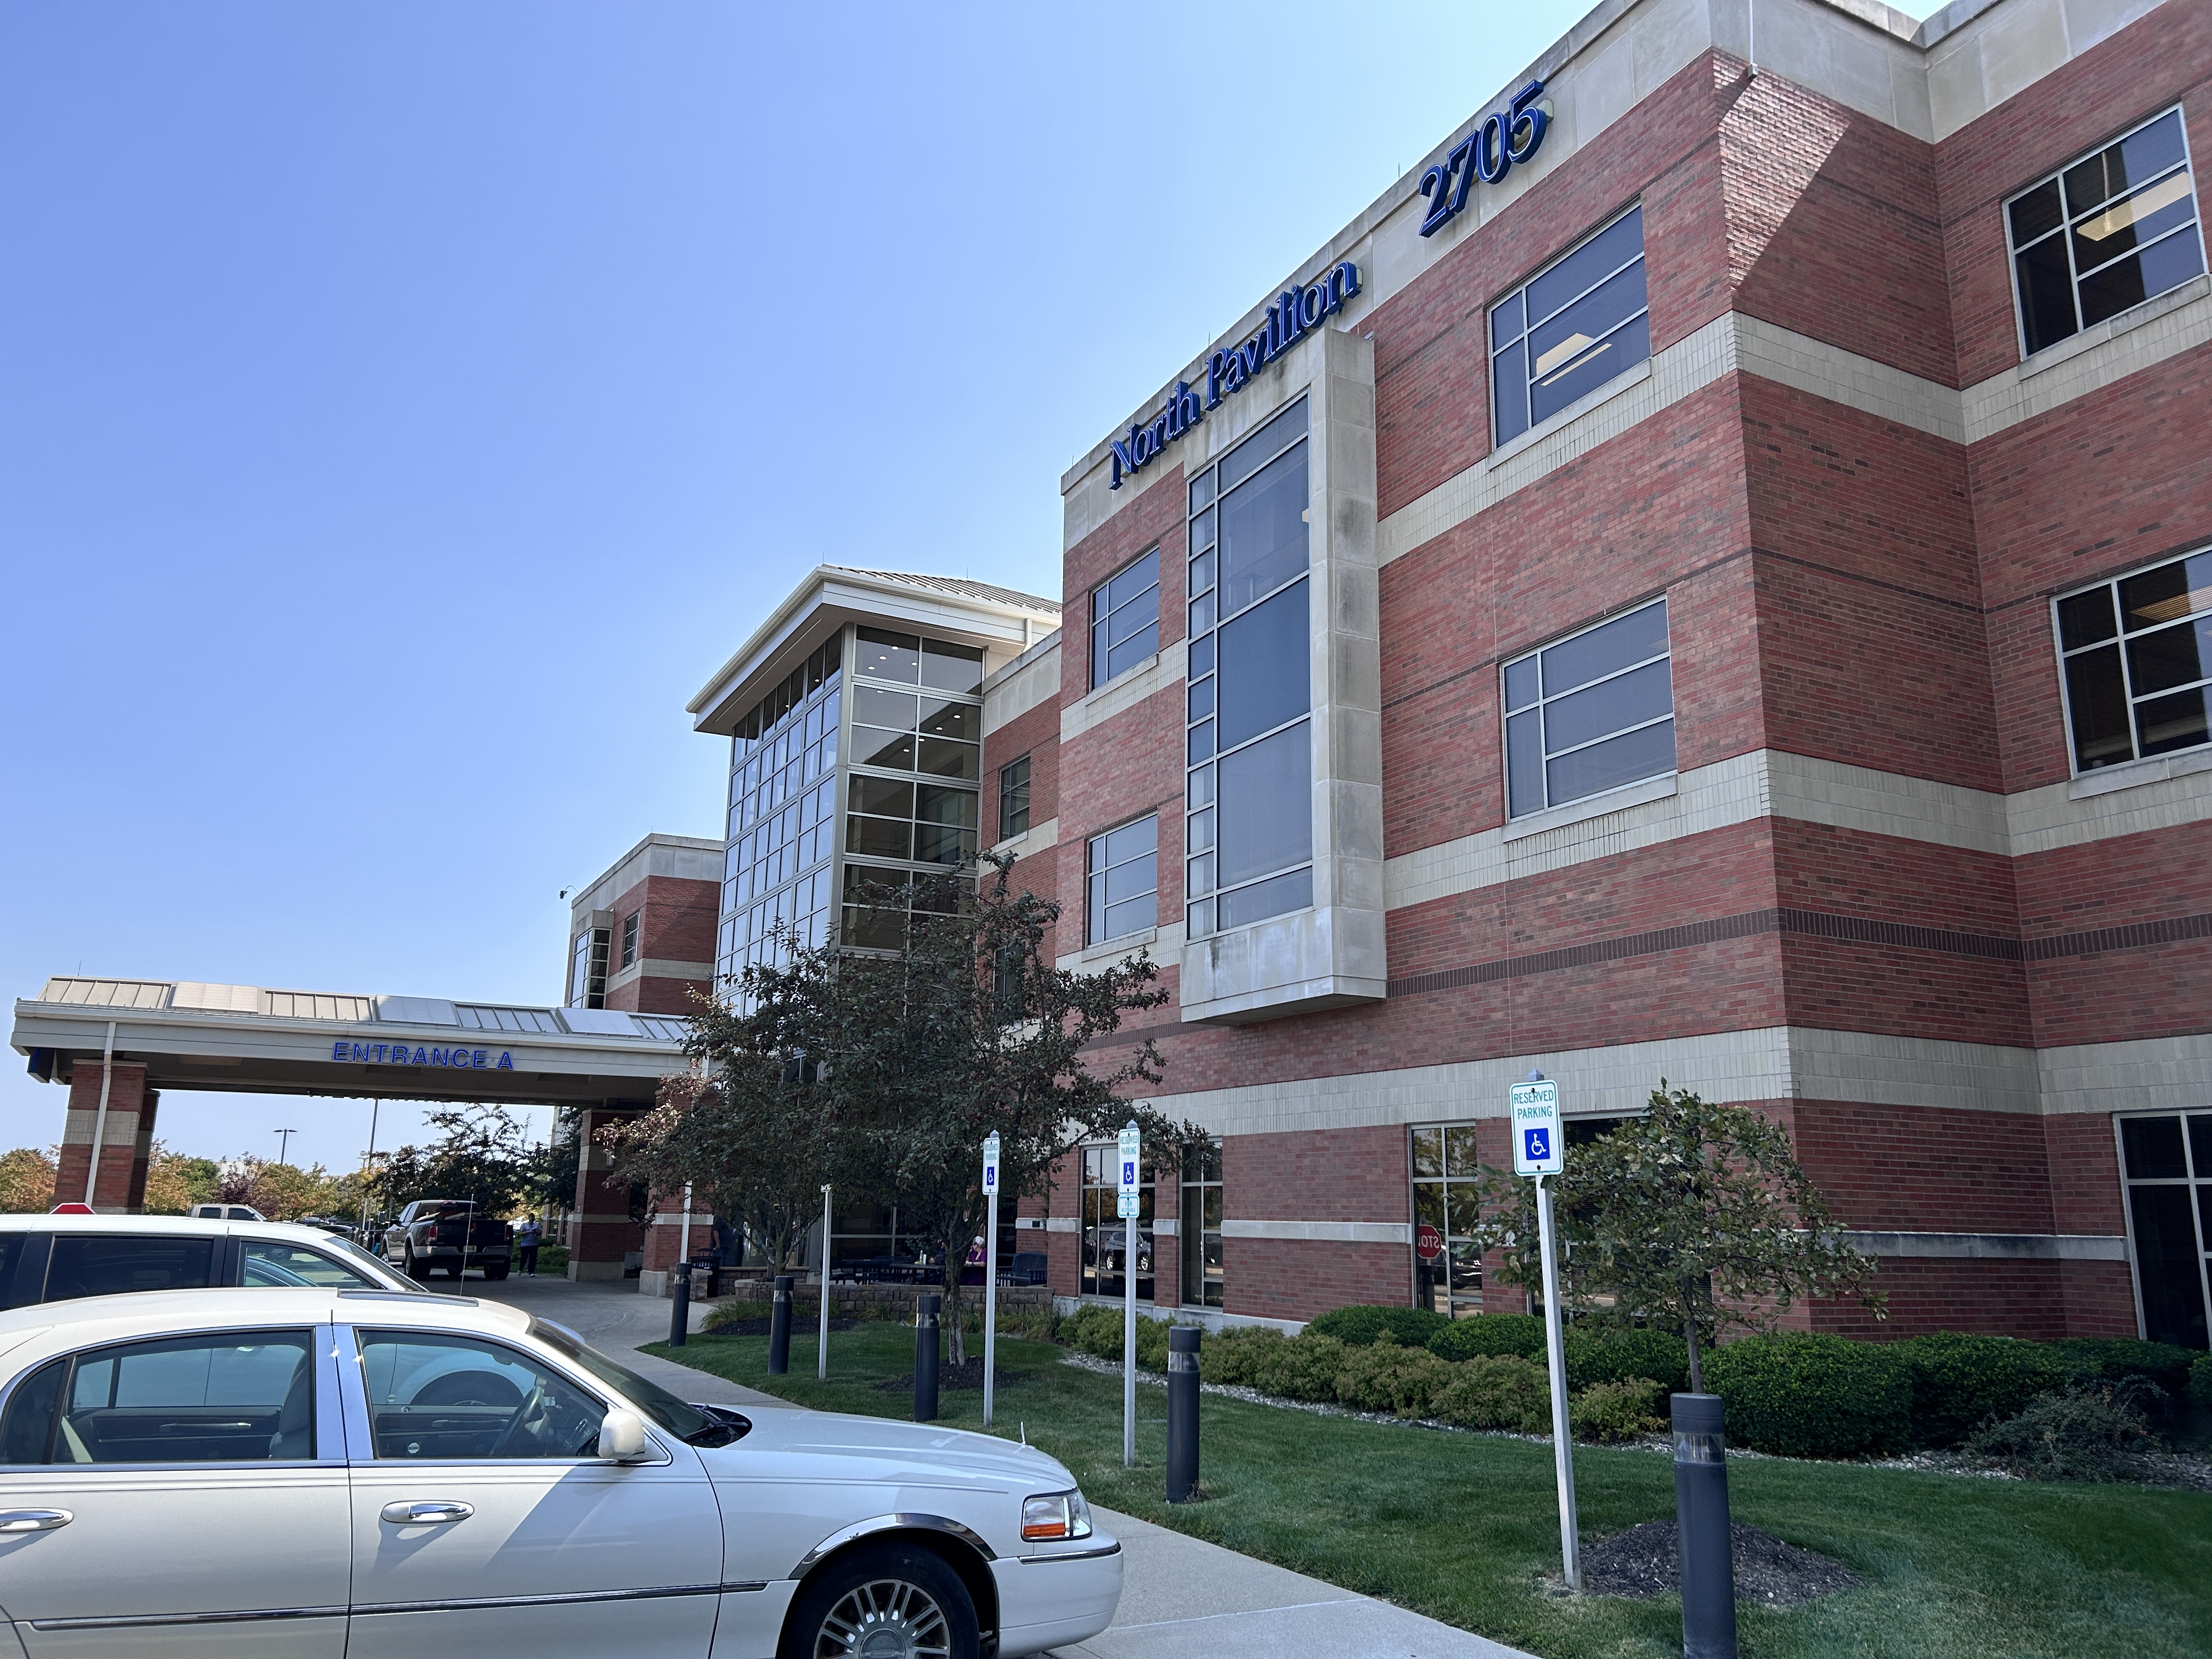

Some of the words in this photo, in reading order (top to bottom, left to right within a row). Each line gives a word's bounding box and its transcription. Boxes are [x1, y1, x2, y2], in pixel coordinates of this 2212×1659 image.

[1419, 80, 1547, 238] 2705
[1108, 381, 1203, 490] North
[1204, 261, 1362, 411] Pavilion
[332, 1042, 488, 1070] ENTRANCE
[495, 1051, 514, 1070] A
[1514, 1090, 1554, 1104] RESERVED
[1517, 1106, 1553, 1120] PARKING
[1121, 1146, 1137, 1155] PARKING
